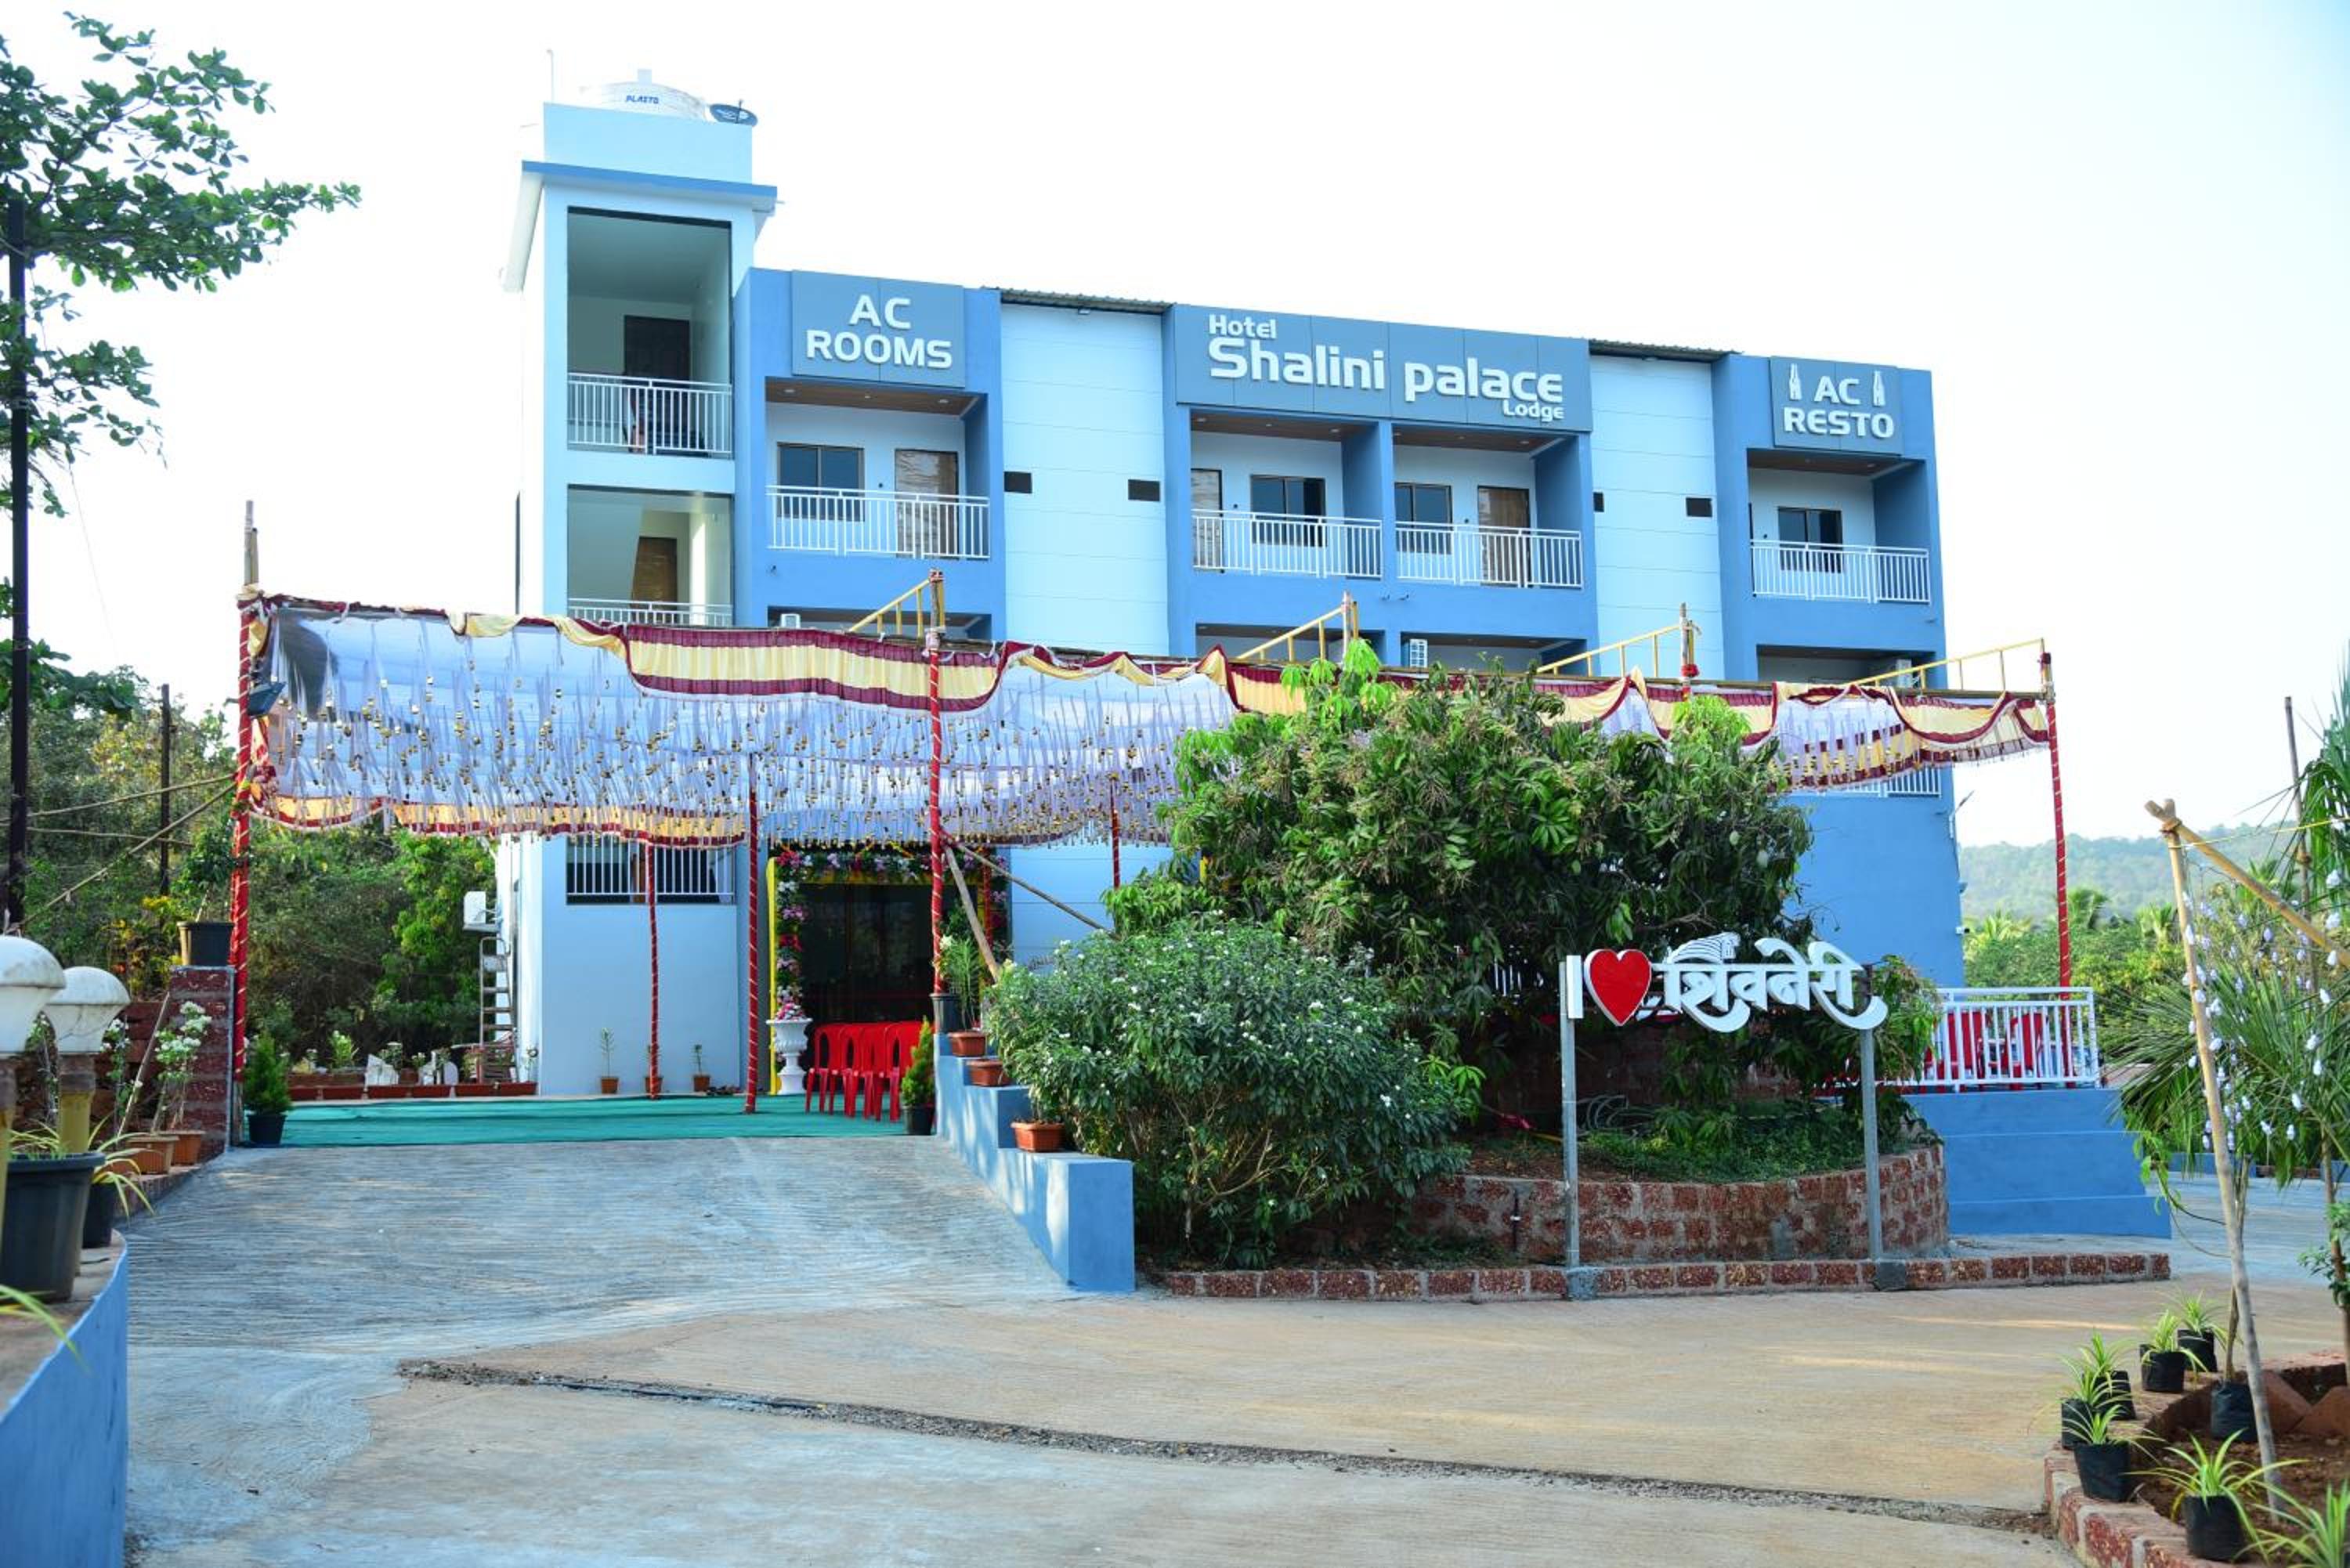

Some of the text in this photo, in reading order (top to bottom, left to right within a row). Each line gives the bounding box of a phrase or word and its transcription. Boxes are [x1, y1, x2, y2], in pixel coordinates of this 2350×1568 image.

[849, 294, 911, 329] AC
[1209, 314, 1277, 339] Hotel
[806, 330, 953, 369] ROOMS
[1209, 336, 1564, 403] Shalini palace
[1813, 376, 1860, 405] AC
[1503, 399, 1564, 422] Lodge
[1783, 406, 1894, 439] RESTO
[1567, 955, 1583, 1019] I
